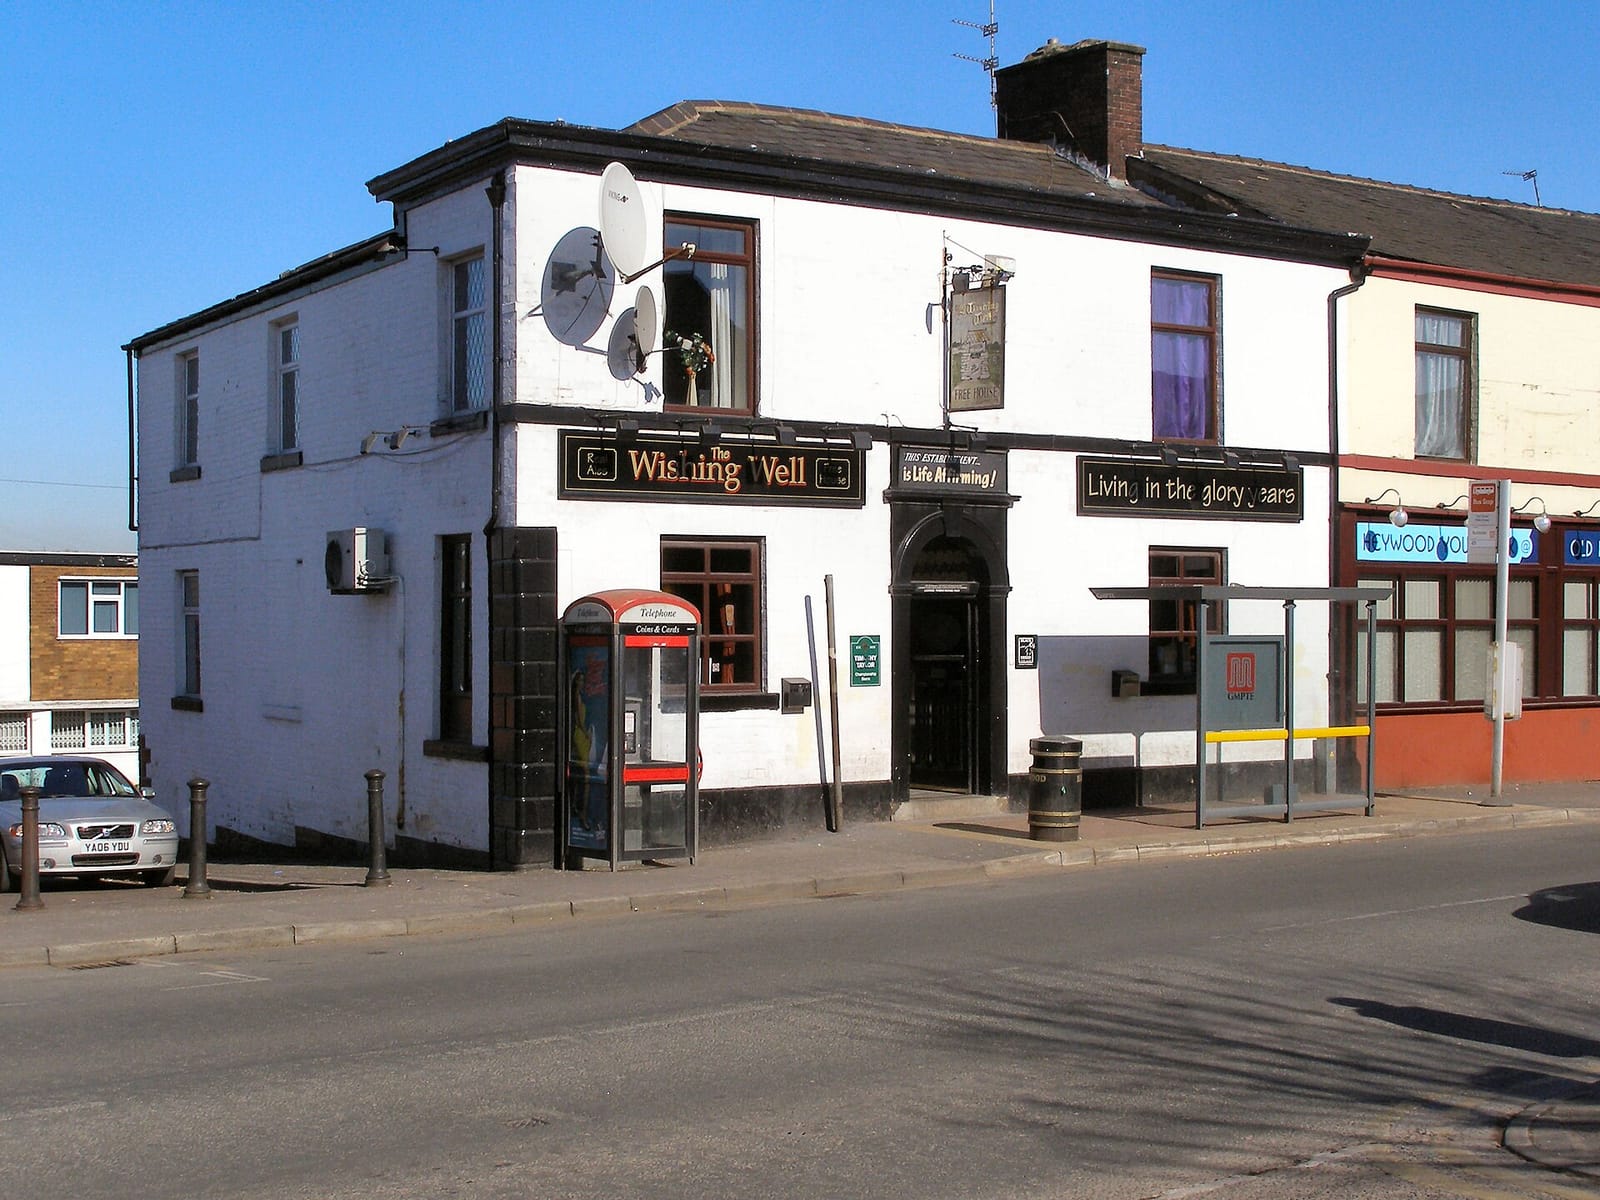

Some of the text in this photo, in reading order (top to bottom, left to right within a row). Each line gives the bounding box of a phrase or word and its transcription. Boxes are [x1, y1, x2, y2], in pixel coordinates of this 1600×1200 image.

[954, 388, 971, 400] FREE
[710, 446, 732, 462] The
[904, 452, 920, 462] THIS
[627, 449, 807, 493] Wishing Well
[903, 466, 911, 482] is
[913, 465, 932, 483] Life
[1088, 472, 1296, 508] Living in the glory years
[1363, 531, 1435, 553] HEYWOOD
[640, 608, 677, 619] Telephone
[635, 625, 680, 634] Coins & Cards
[1227, 692, 1255, 701] GMPTE
[85, 842, 130, 852] YA06 YDU
